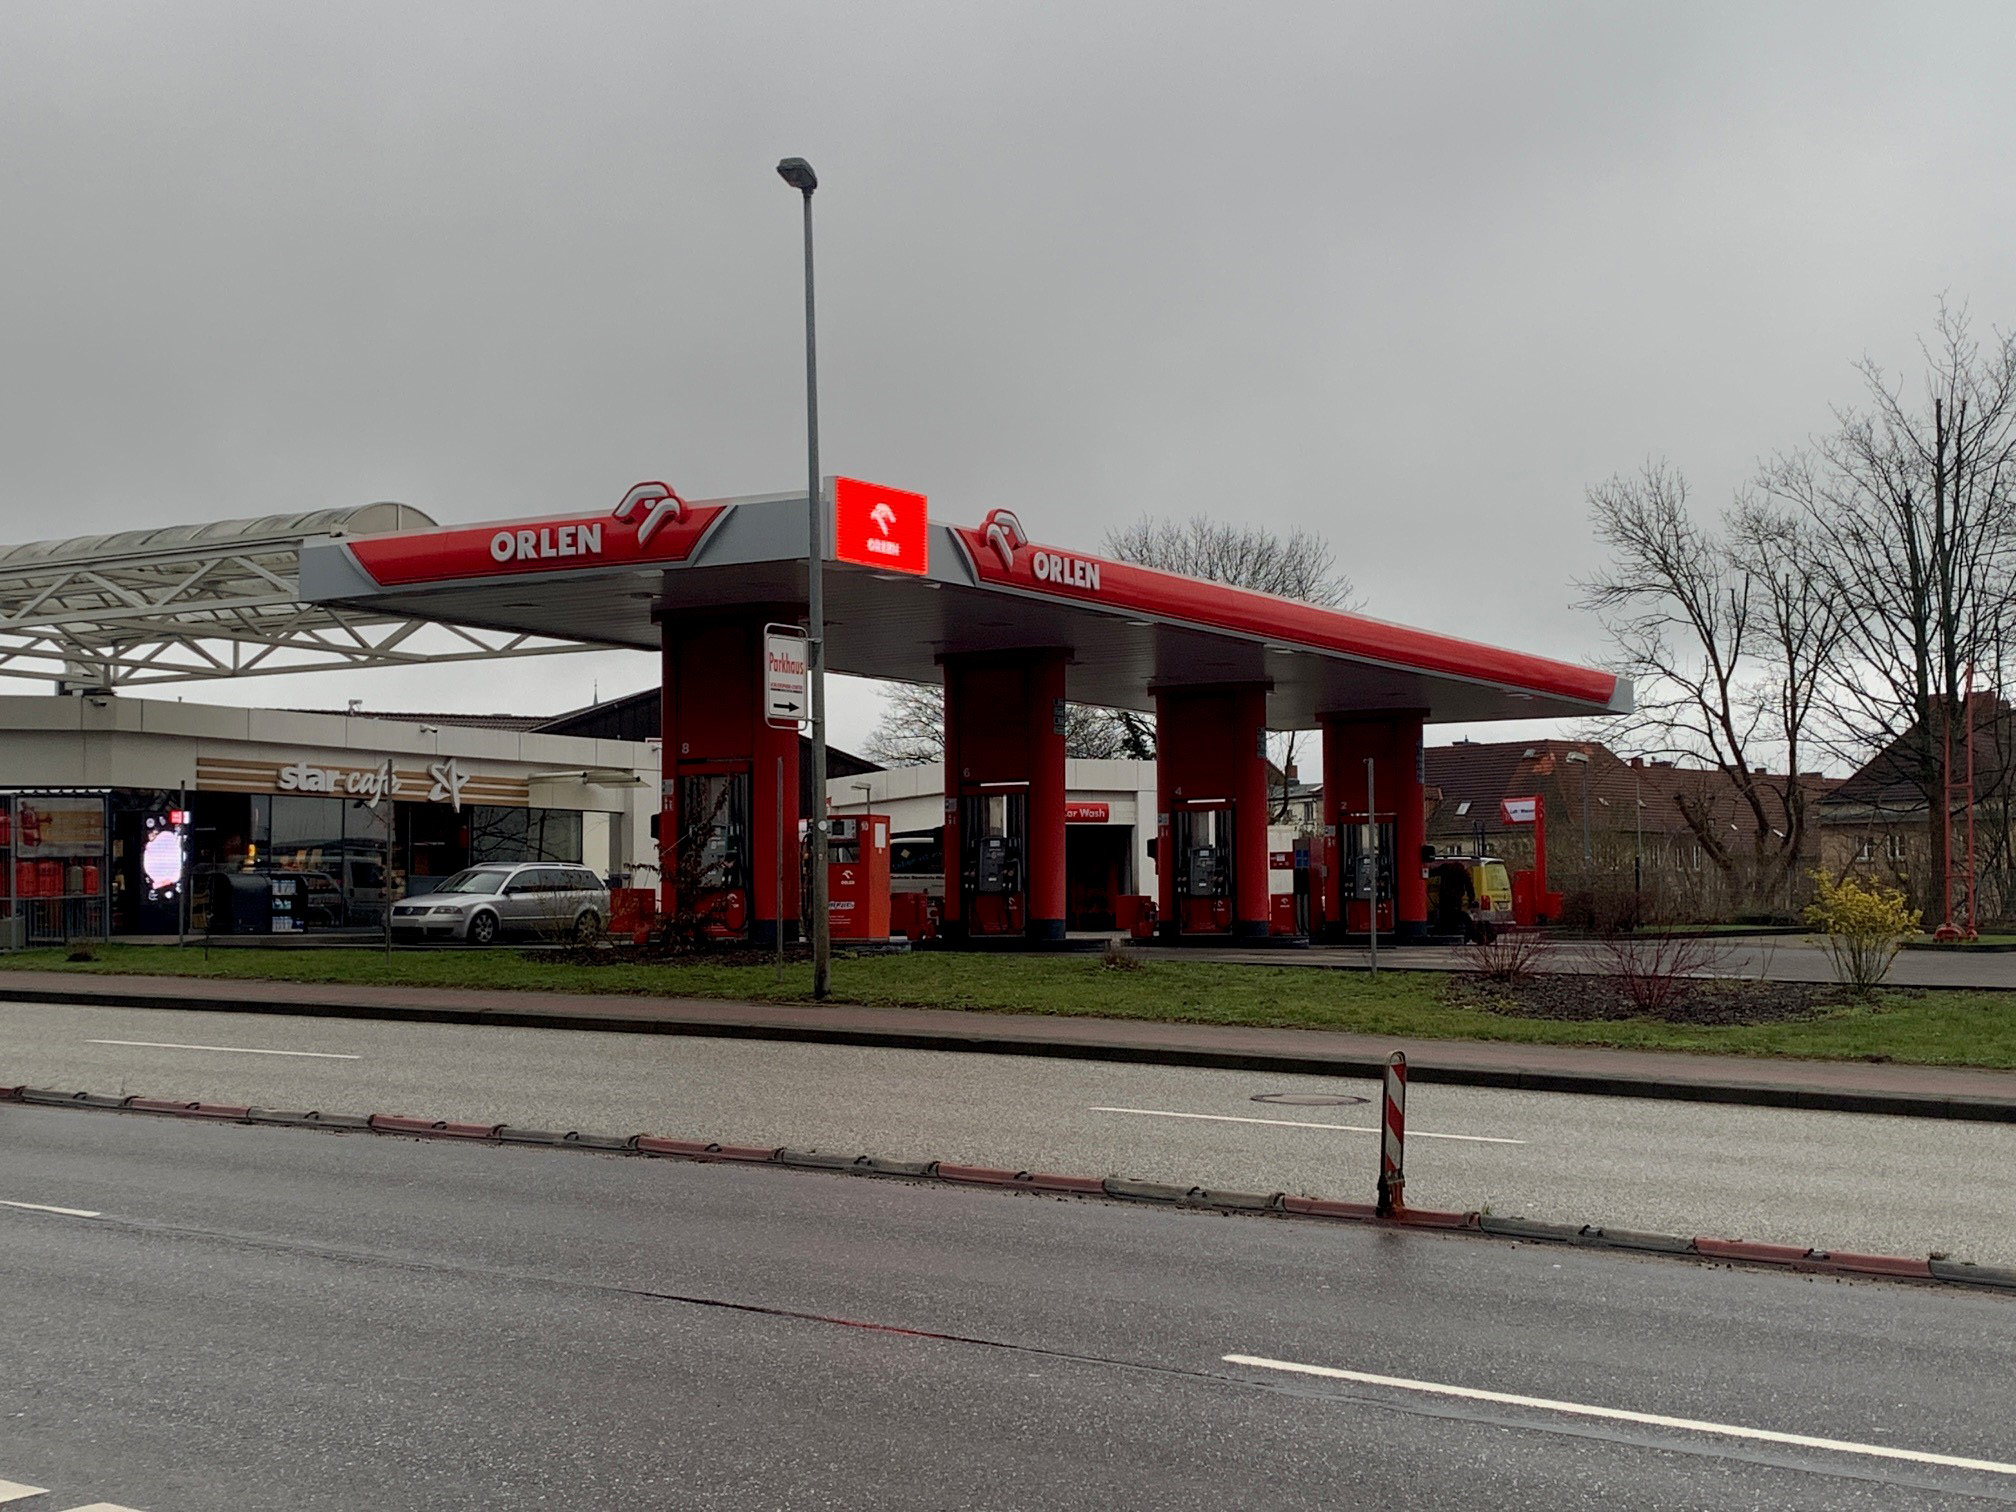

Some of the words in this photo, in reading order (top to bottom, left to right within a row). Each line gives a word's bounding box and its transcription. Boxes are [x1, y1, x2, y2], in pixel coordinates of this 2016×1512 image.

[490, 522, 602, 562] ORLEN
[1033, 551, 1101, 591] ORLEN
[768, 652, 804, 675] Parkhaus
[682, 742, 690, 754] 8
[278, 763, 340, 793] star
[962, 767, 971, 778] 6
[1174, 786, 1183, 796] 4
[1340, 801, 1348, 810] 2
[1080, 808, 1105, 818] Wash
